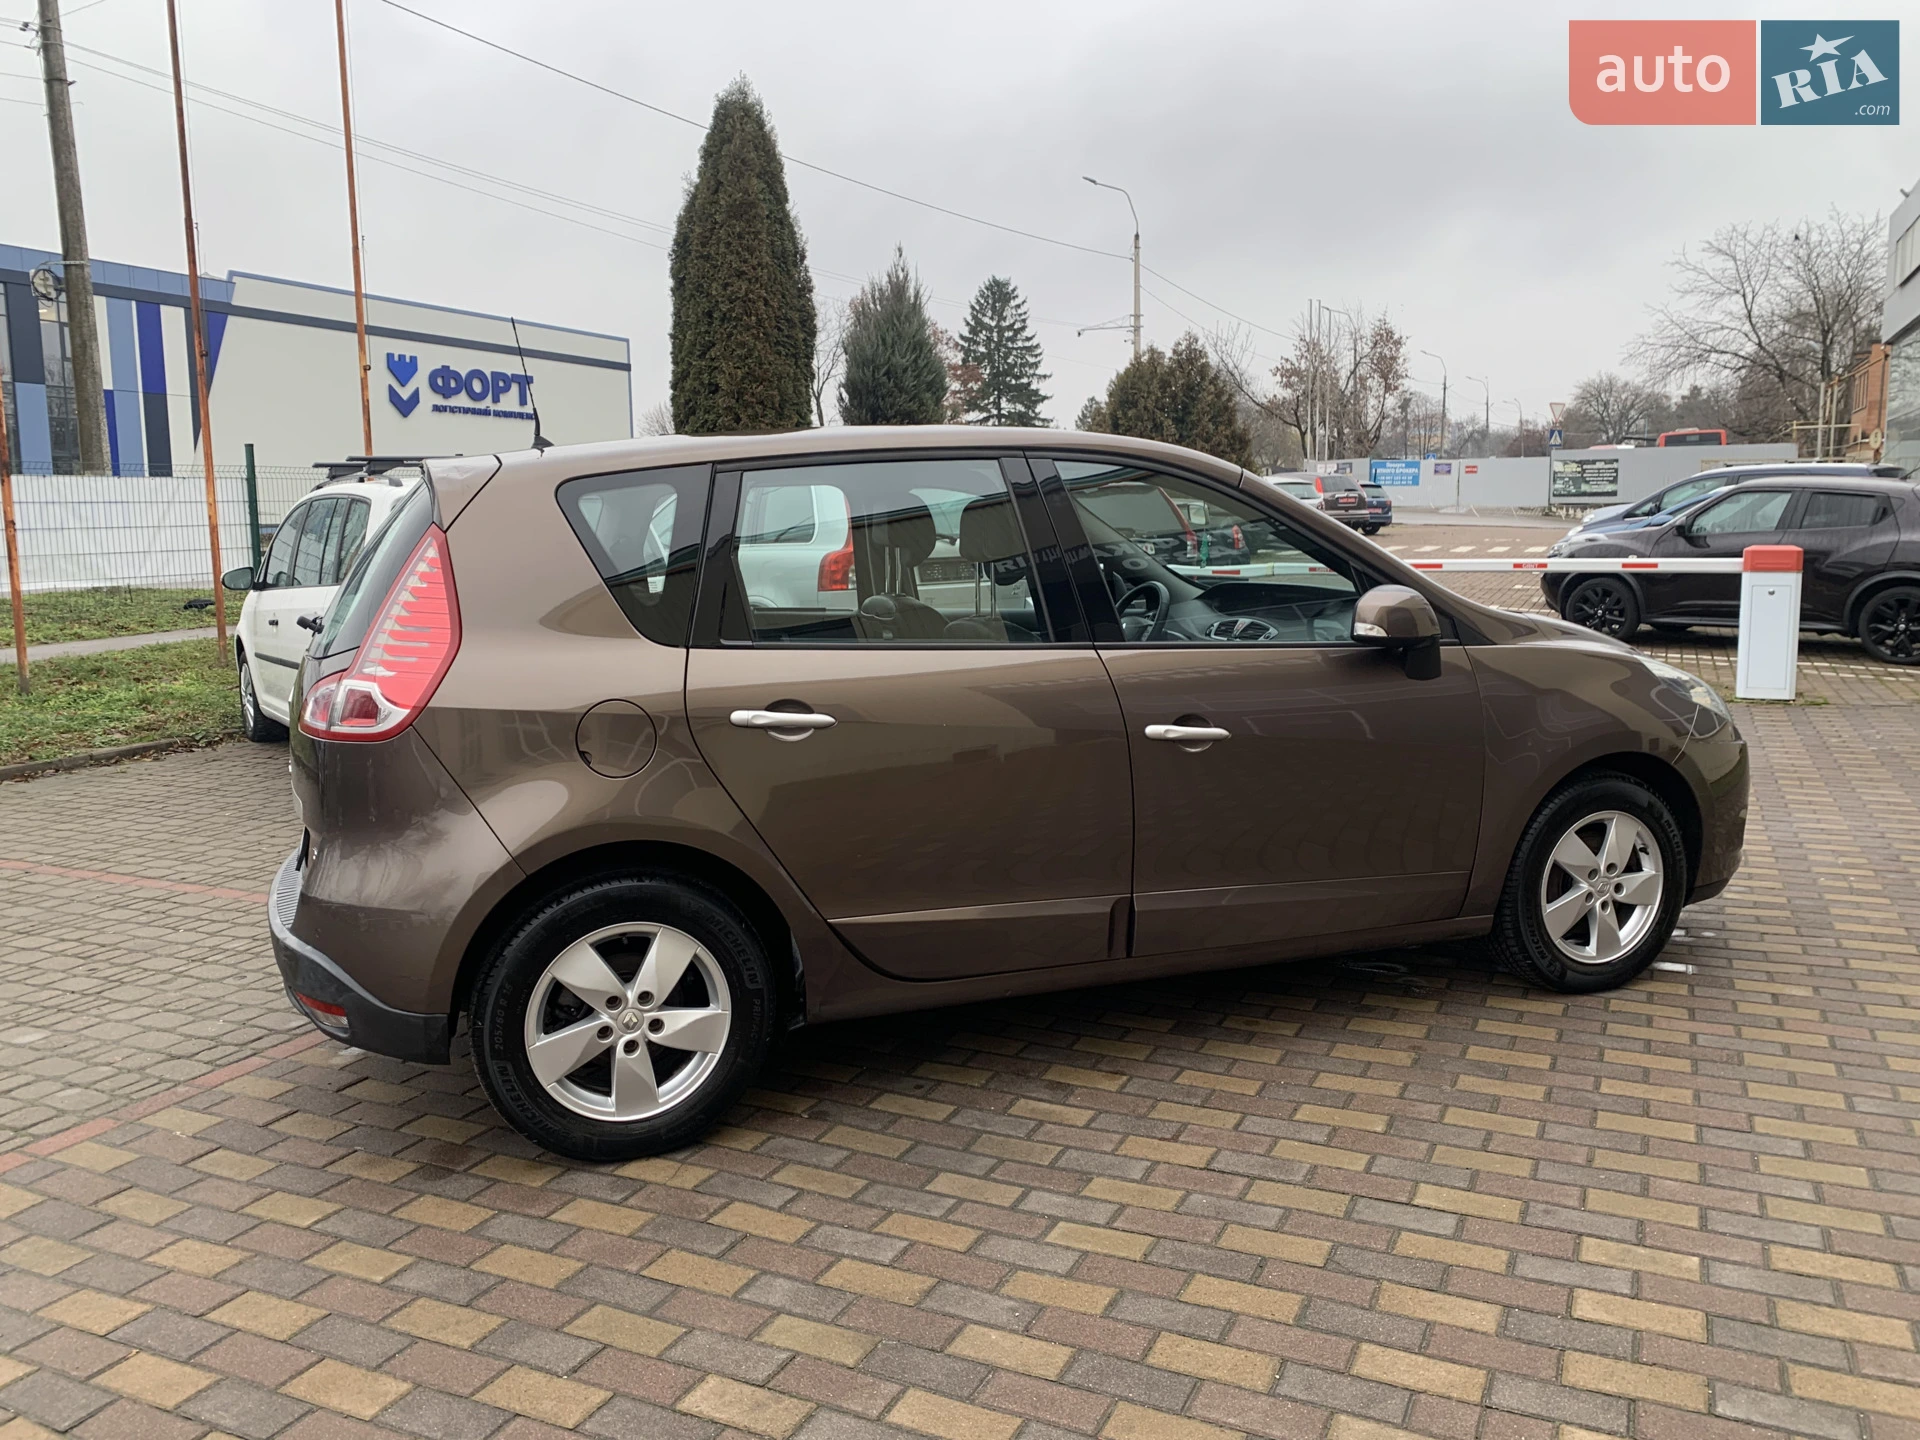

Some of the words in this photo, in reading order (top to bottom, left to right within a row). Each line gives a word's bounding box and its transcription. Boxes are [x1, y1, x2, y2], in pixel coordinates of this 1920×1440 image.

[428, 365, 534, 406] ФОРТ
[432, 404, 492, 415] ЛОГІСТИЧНИЙ
[705, 914, 761, 986] MICHELIN
